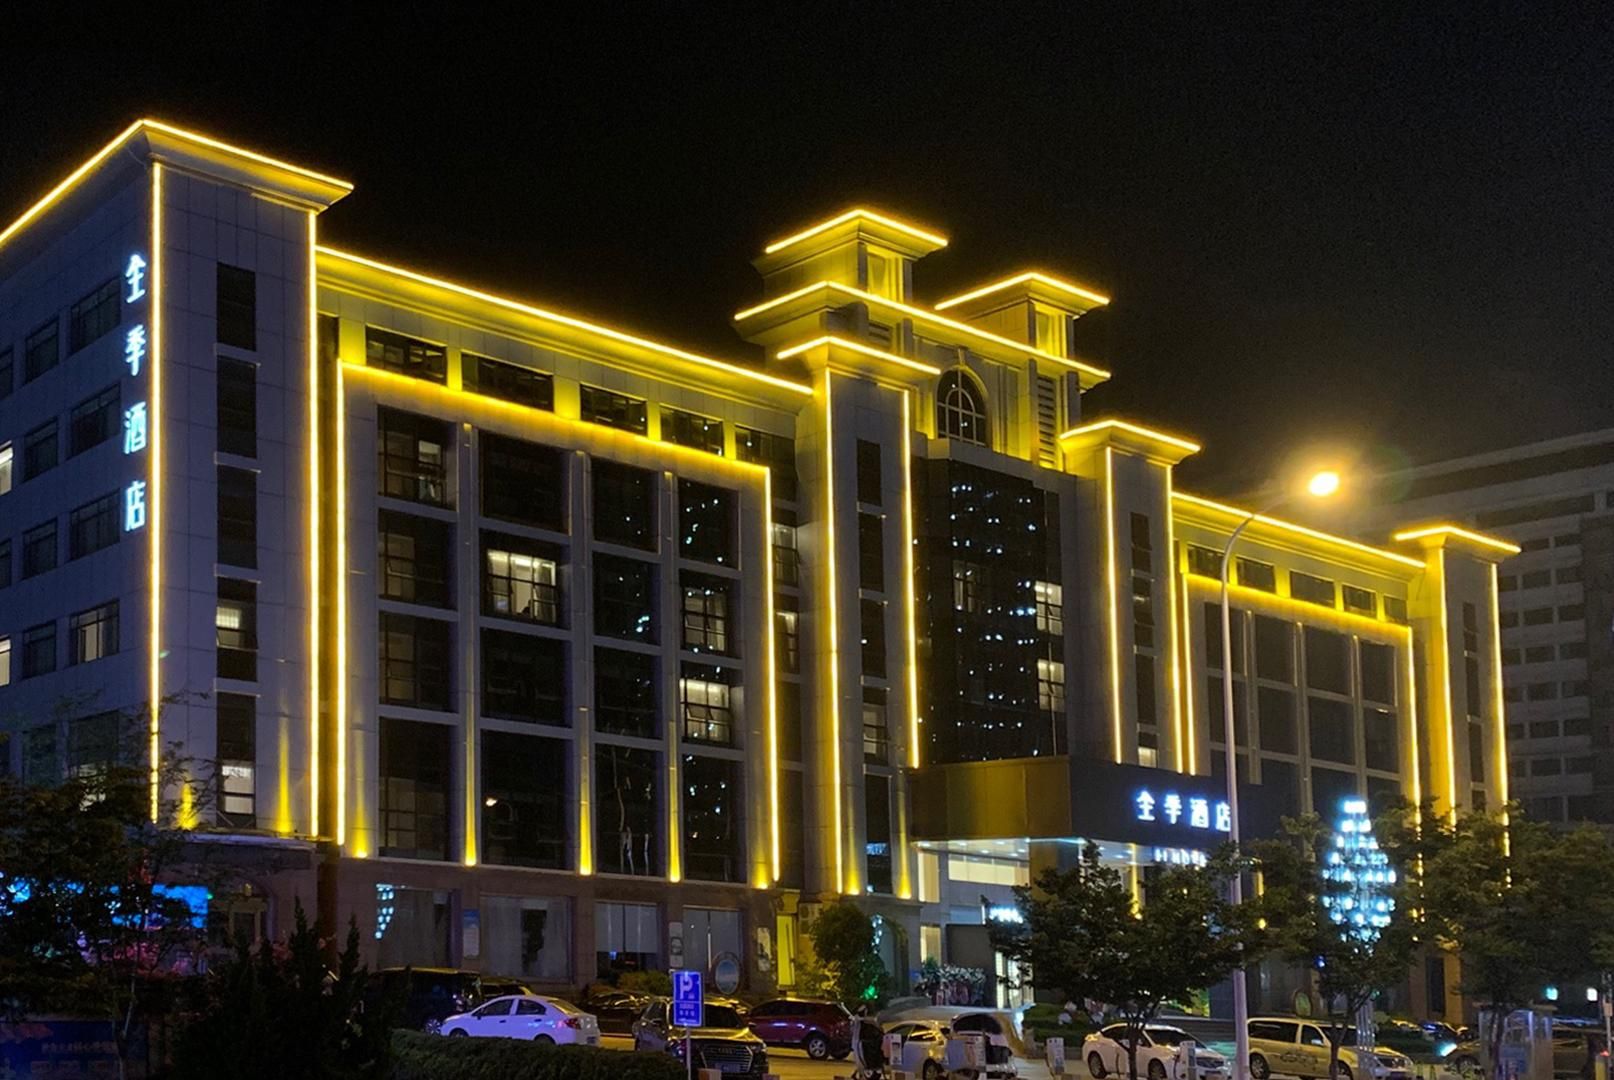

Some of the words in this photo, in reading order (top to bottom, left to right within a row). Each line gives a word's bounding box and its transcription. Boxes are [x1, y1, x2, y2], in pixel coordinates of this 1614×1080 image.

[124, 253, 147, 532] 全季酒店
[1136, 790, 1231, 832] 全季酒店
[679, 975, 693, 1000] P
